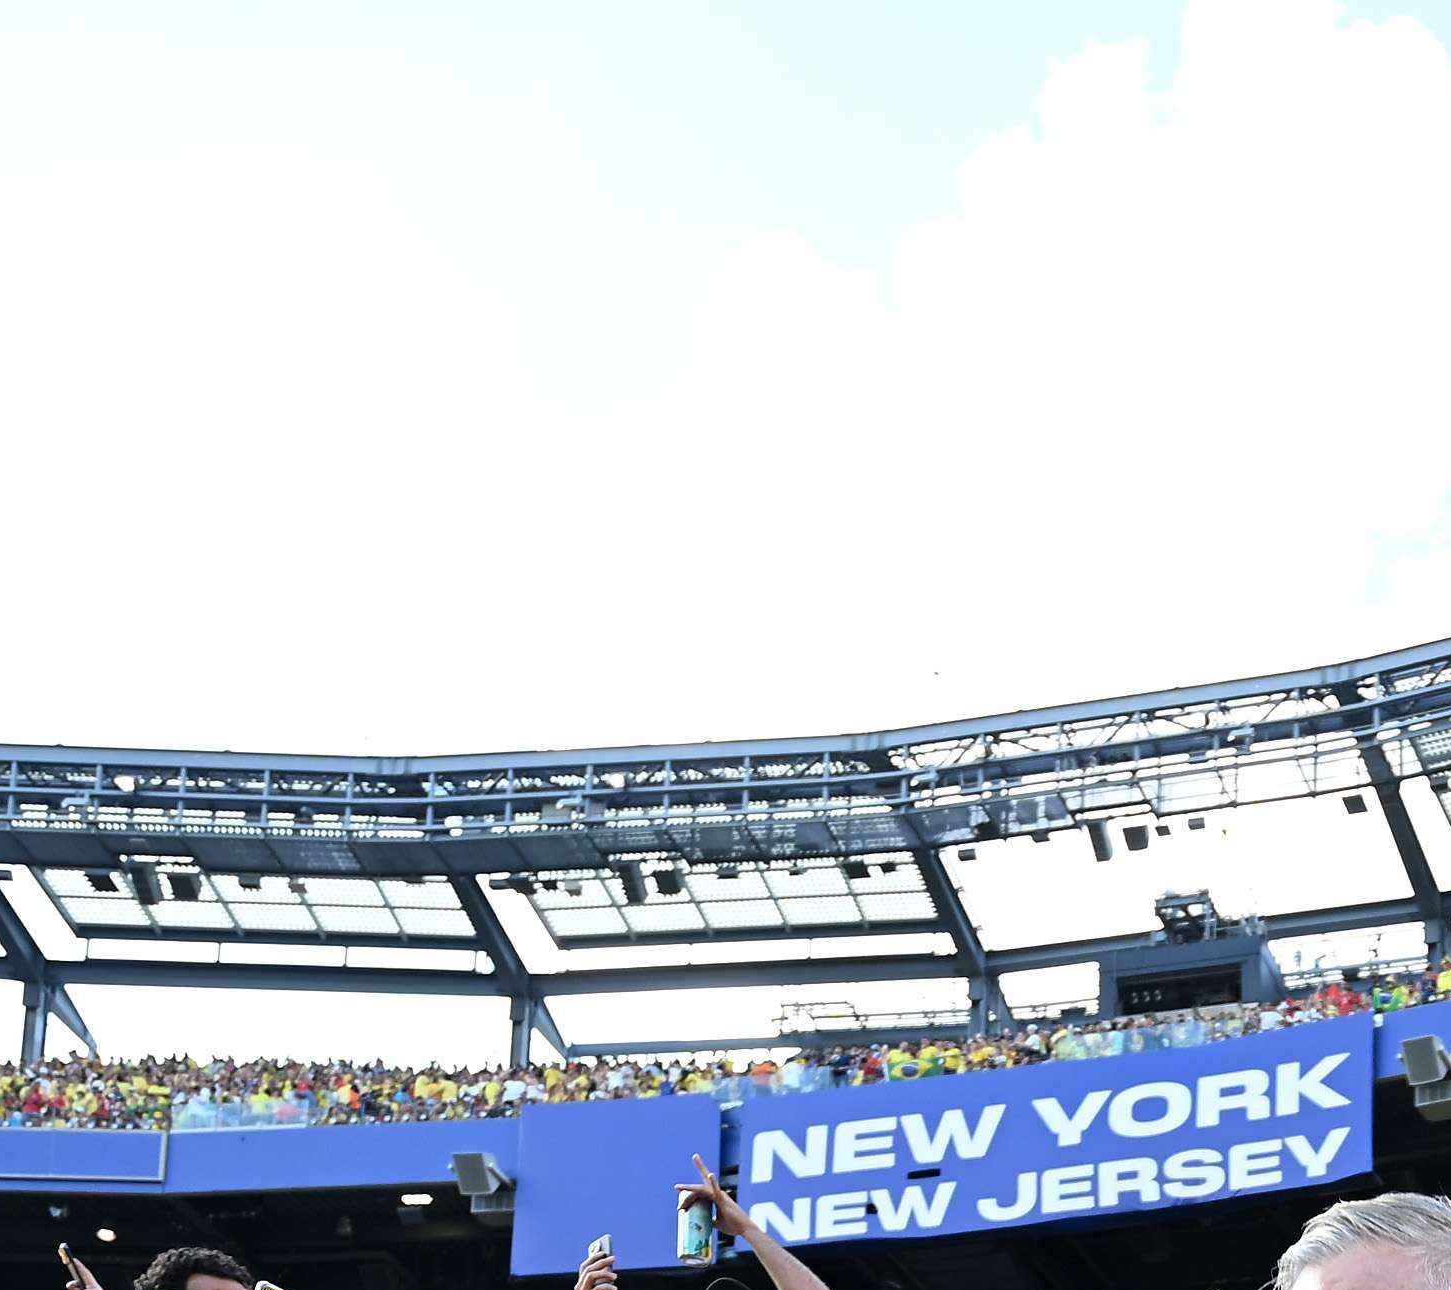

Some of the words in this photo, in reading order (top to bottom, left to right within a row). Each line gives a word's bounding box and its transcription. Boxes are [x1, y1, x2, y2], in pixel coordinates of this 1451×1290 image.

[750, 1103, 1007, 1184] NEW
[1033, 1052, 1352, 1147] YORK
[747, 1181, 957, 1243] NEW
[977, 1126, 1352, 1221] JERSEY
